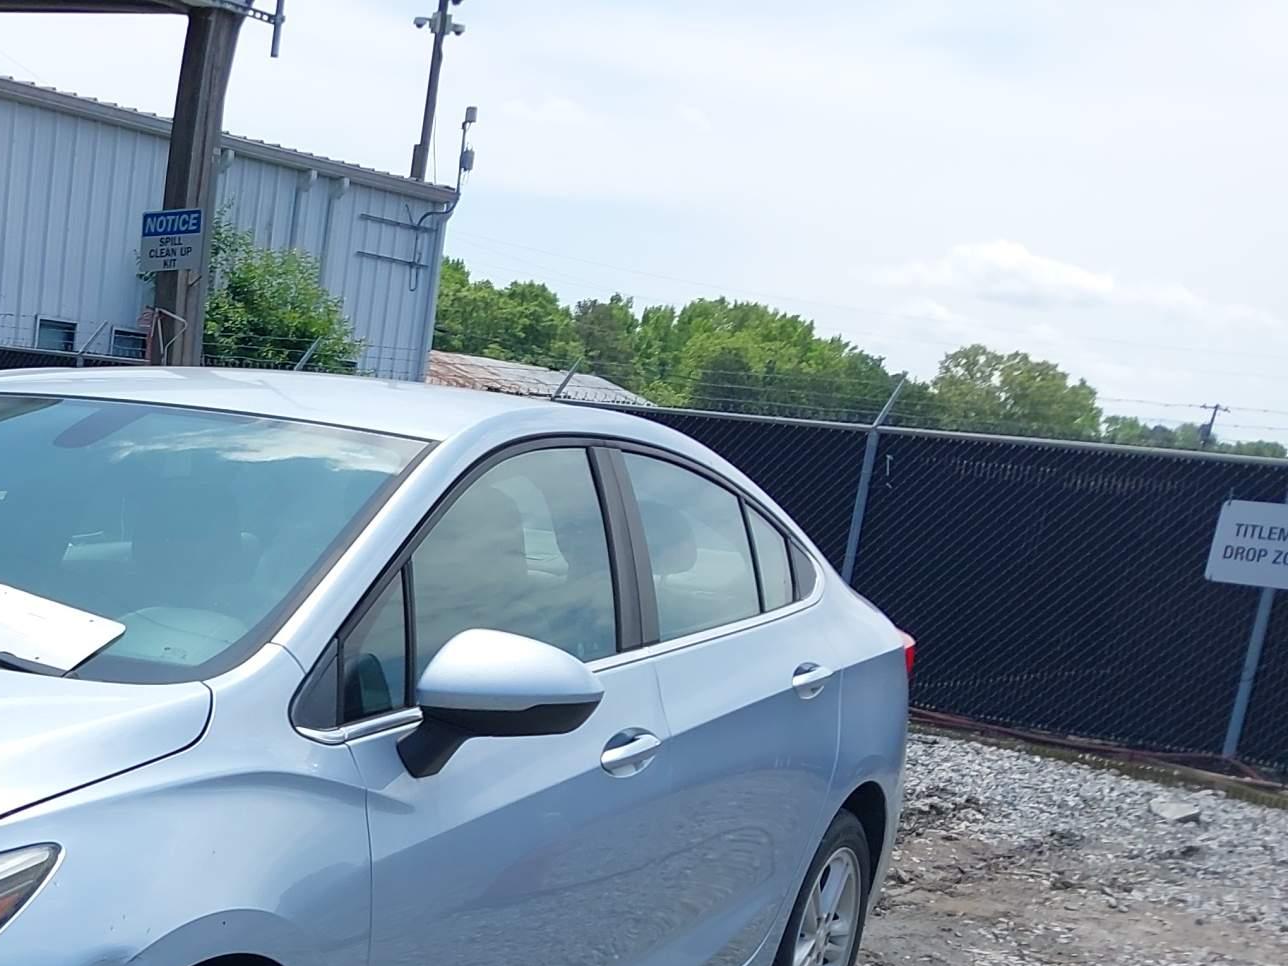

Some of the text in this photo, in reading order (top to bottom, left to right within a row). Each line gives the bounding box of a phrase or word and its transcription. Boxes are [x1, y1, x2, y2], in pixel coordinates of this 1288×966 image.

[144, 213, 200, 233] NOTICE
[159, 236, 183, 247] SPILL
[149, 246, 192, 258] CLEAN UP
[163, 259, 176, 269] KIT
[1223, 545, 1268, 563] DROP
